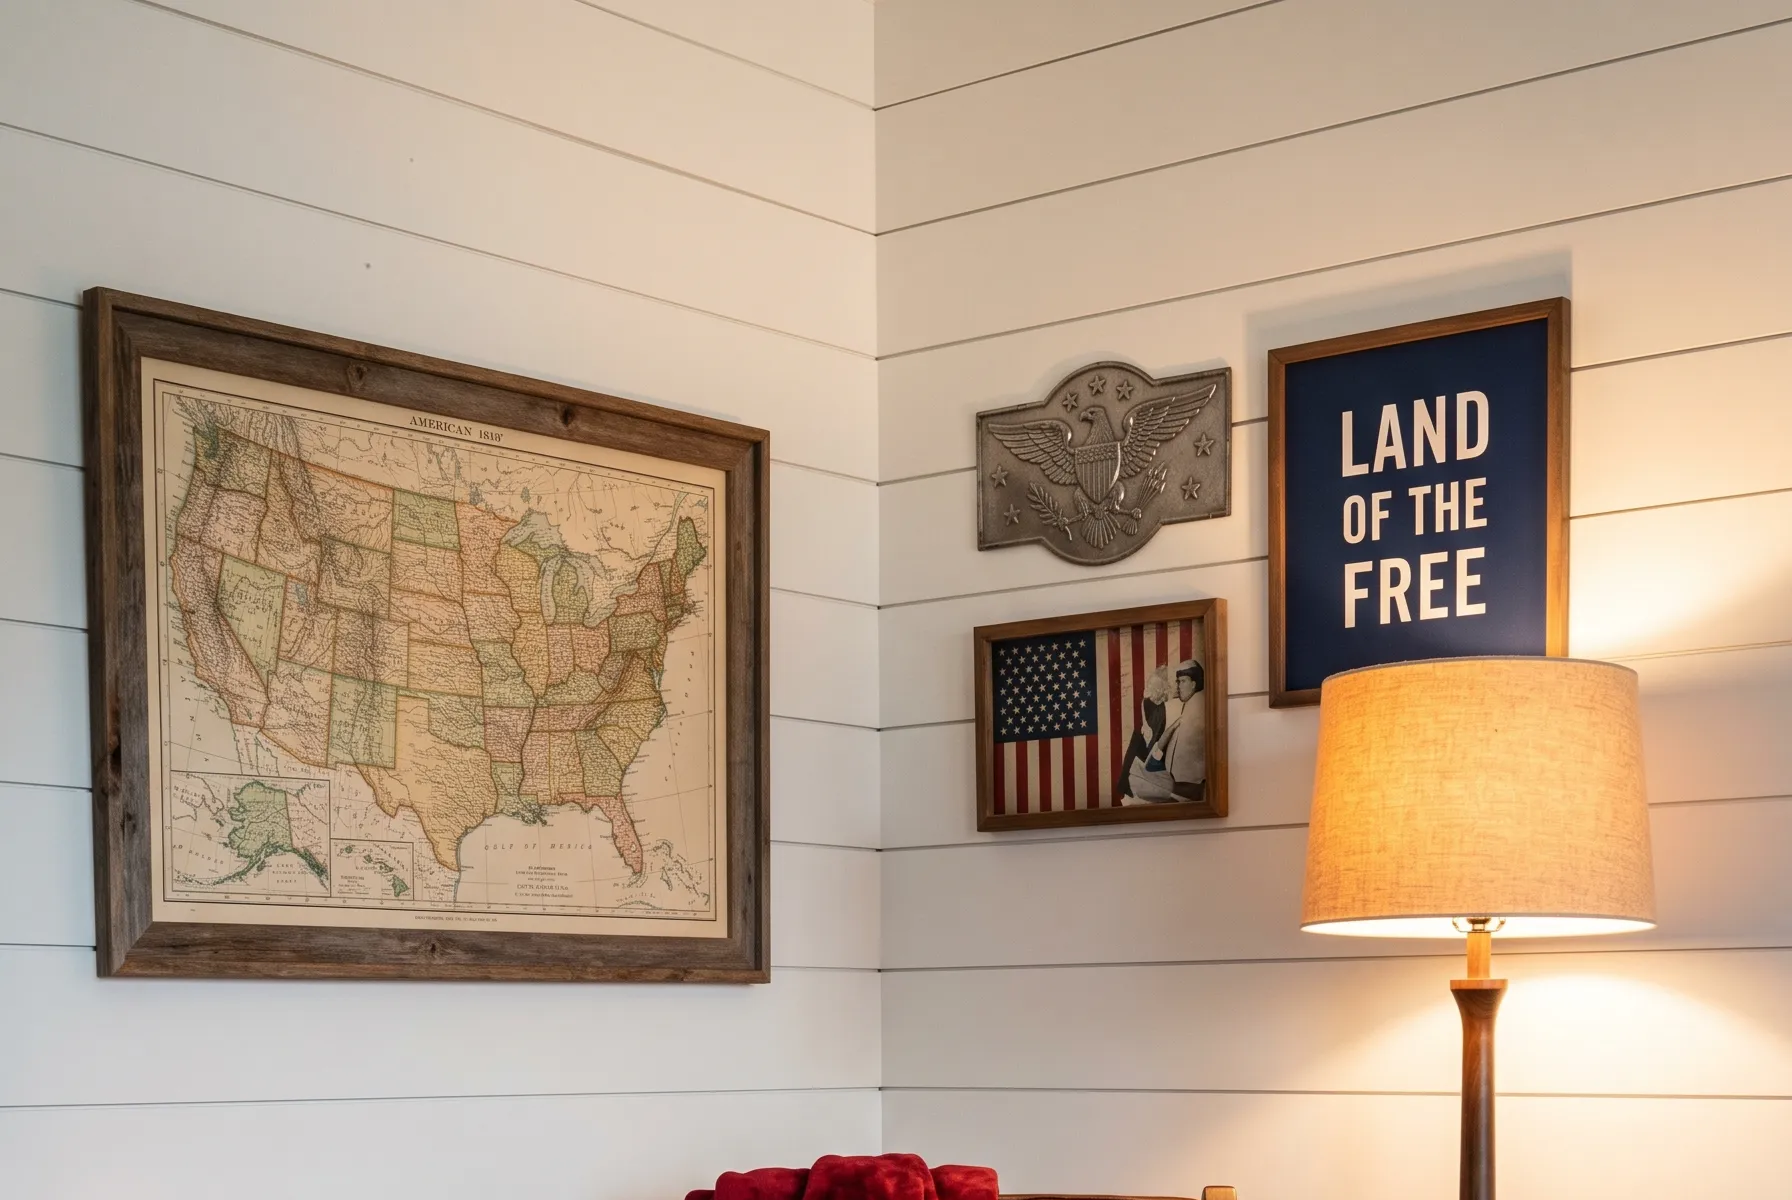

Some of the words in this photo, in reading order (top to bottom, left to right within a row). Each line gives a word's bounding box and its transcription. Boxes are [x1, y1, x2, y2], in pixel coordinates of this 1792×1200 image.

[410, 415, 472, 436] AMERICAN
[1342, 390, 1489, 478] LAND
[1343, 490, 1392, 544] OF
[1408, 477, 1487, 535] THE
[1344, 547, 1486, 628] FREE
